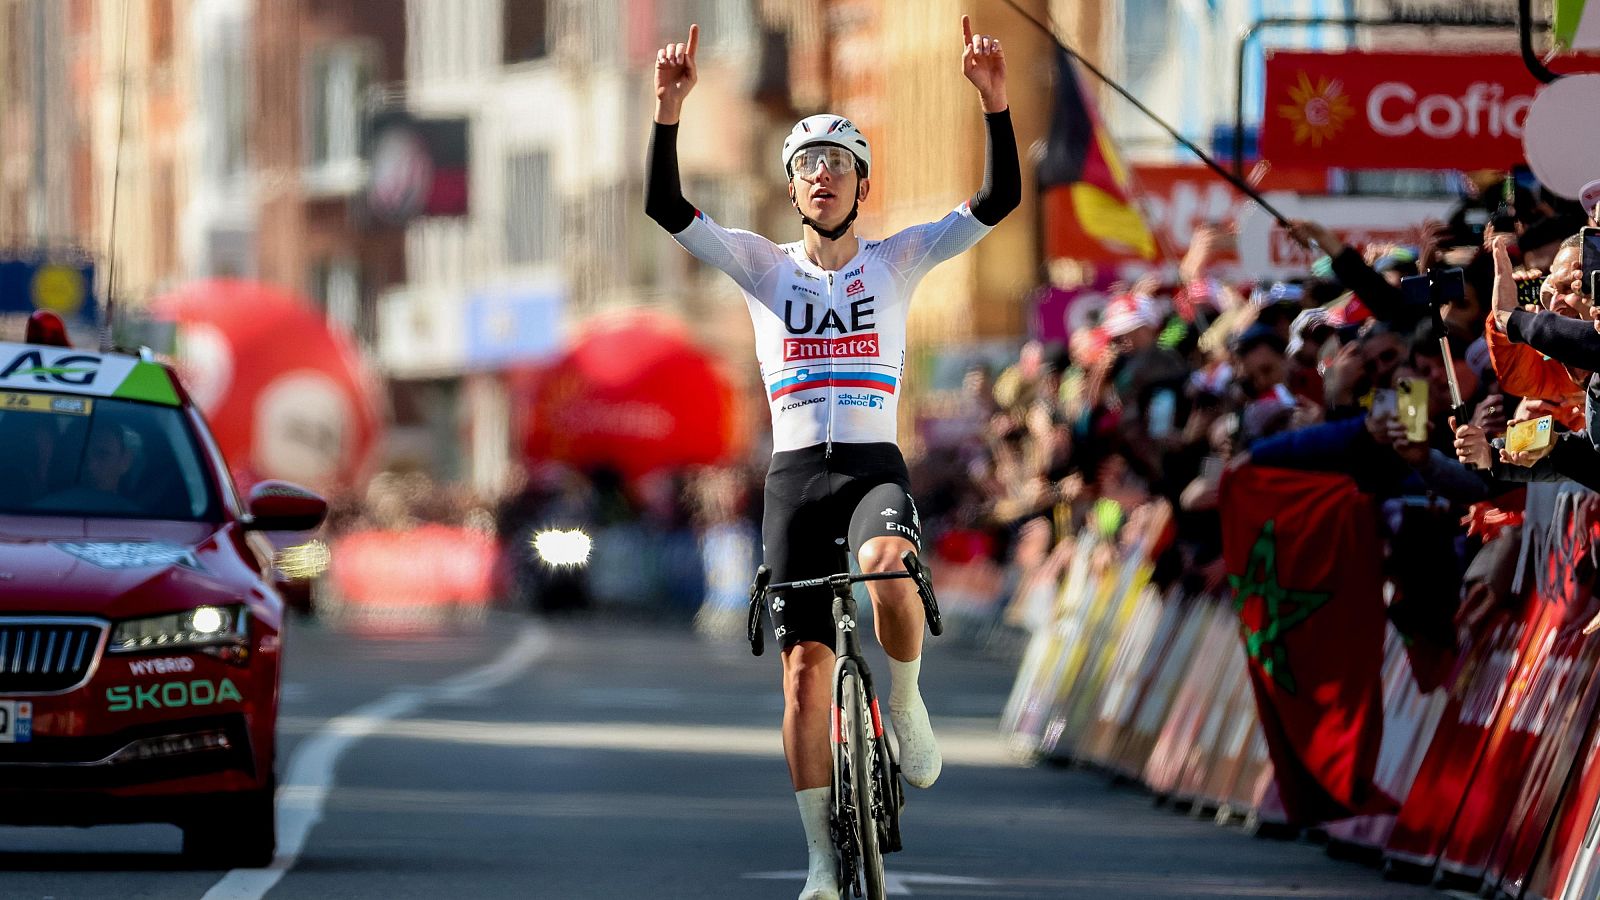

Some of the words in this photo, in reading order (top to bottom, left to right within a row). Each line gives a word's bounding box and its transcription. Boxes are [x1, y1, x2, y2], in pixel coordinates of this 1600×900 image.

[785, 296, 875, 335] UAE
[786, 339, 877, 358] Emirates
[0, 349, 101, 385] AG
[787, 396, 826, 410] COLNAGO
[838, 399, 868, 407] ADNOC
[129, 656, 195, 676] HYBRID
